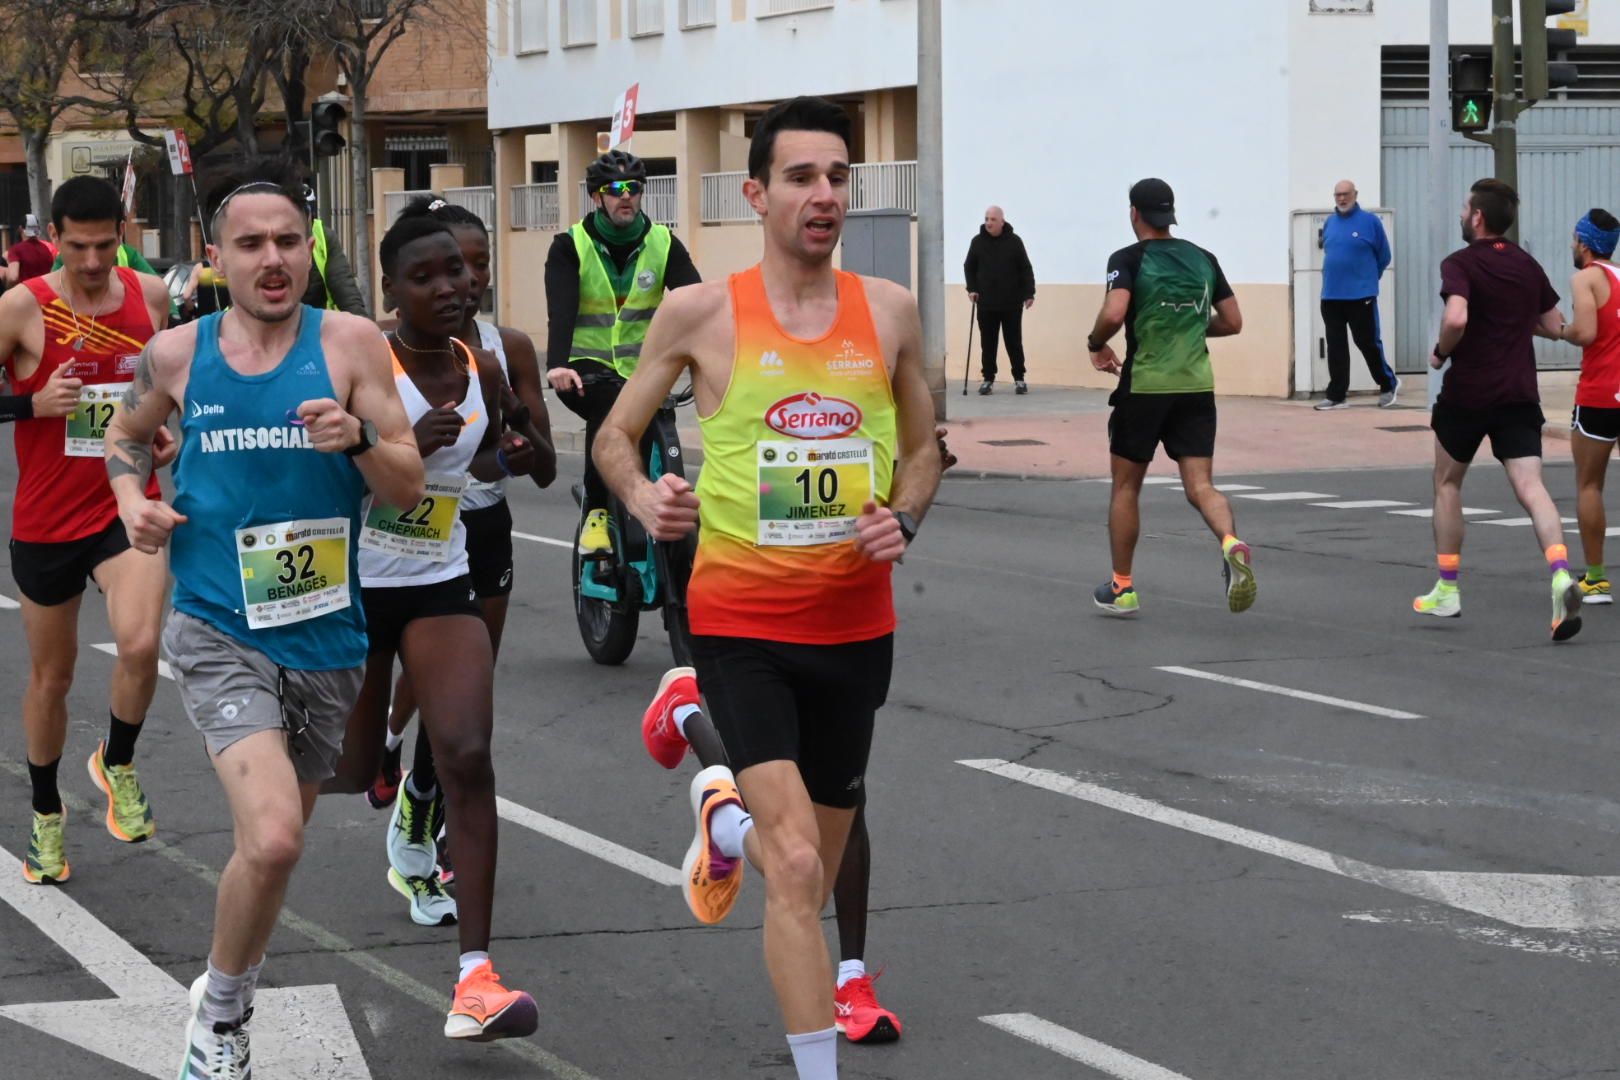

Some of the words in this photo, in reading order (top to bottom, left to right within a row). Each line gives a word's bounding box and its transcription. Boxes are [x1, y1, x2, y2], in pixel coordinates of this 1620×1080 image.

[623, 99, 633, 128] 3
[179, 139, 188, 162] 2
[85, 403, 114, 428] 12
[203, 404, 224, 414] Delta
[774, 408, 855, 430] Serrano
[201, 427, 314, 453] ANTISOCIAL
[796, 468, 838, 504] 10
[397, 497, 435, 525] 22
[786, 504, 846, 518] JIMENEZ
[377, 519, 441, 538] CHEPKIACH
[275, 545, 316, 584] 32
[267, 575, 328, 600] BENAGES
